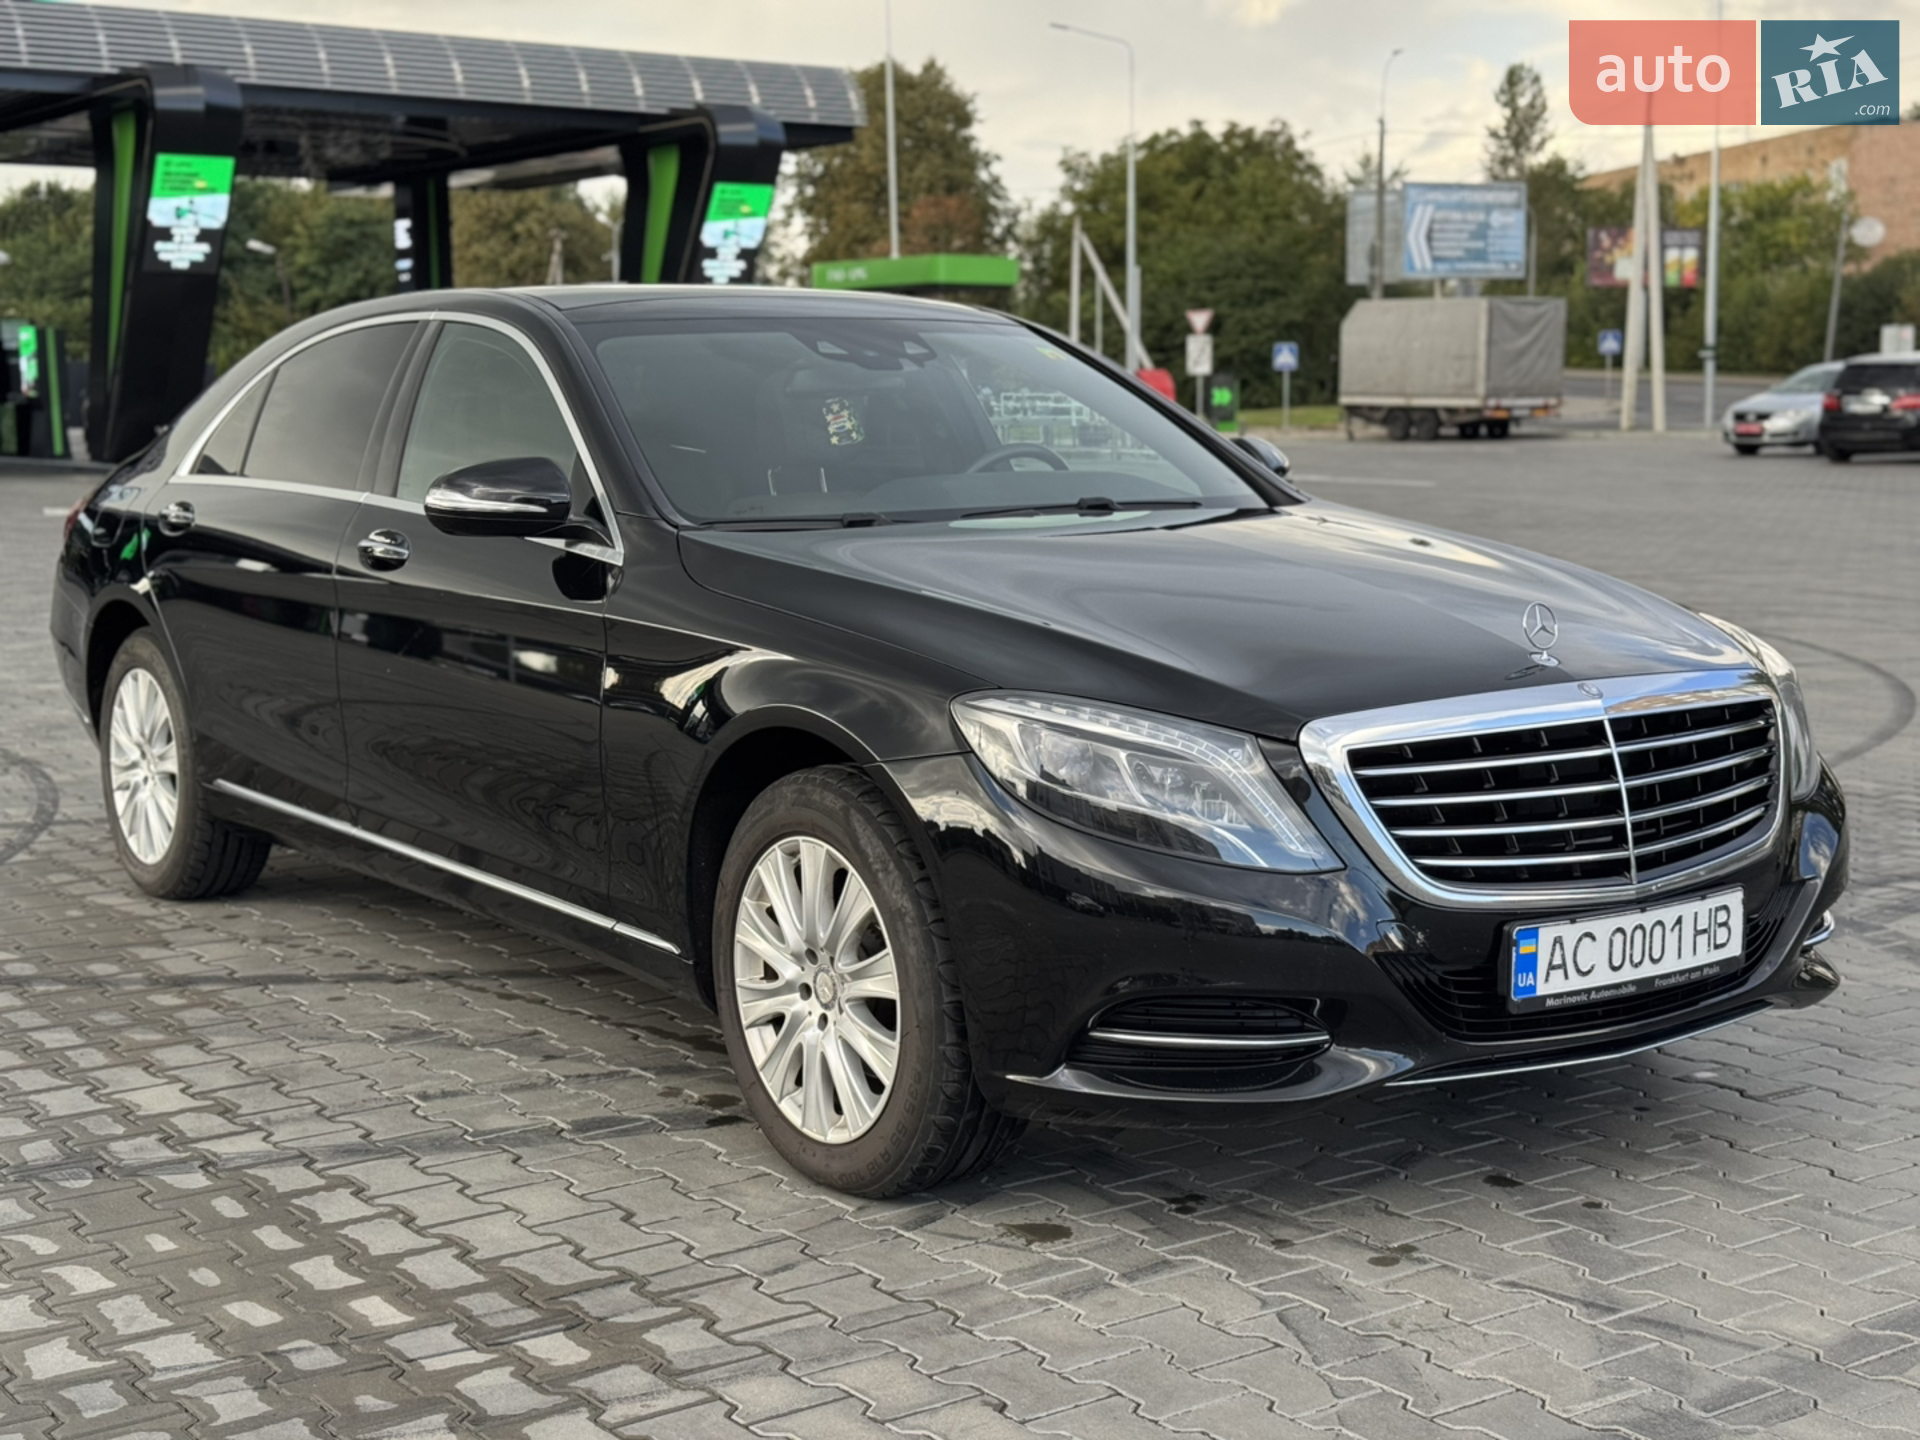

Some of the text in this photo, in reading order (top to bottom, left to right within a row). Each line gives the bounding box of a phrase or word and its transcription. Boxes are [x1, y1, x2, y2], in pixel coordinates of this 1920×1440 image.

[1544, 904, 1732, 984] AC 0001 HB
[1518, 972, 1535, 988] UA
[1655, 964, 1720, 988] Frankfurt am Main
[1545, 982, 1637, 1007] Marinovic Automobile
